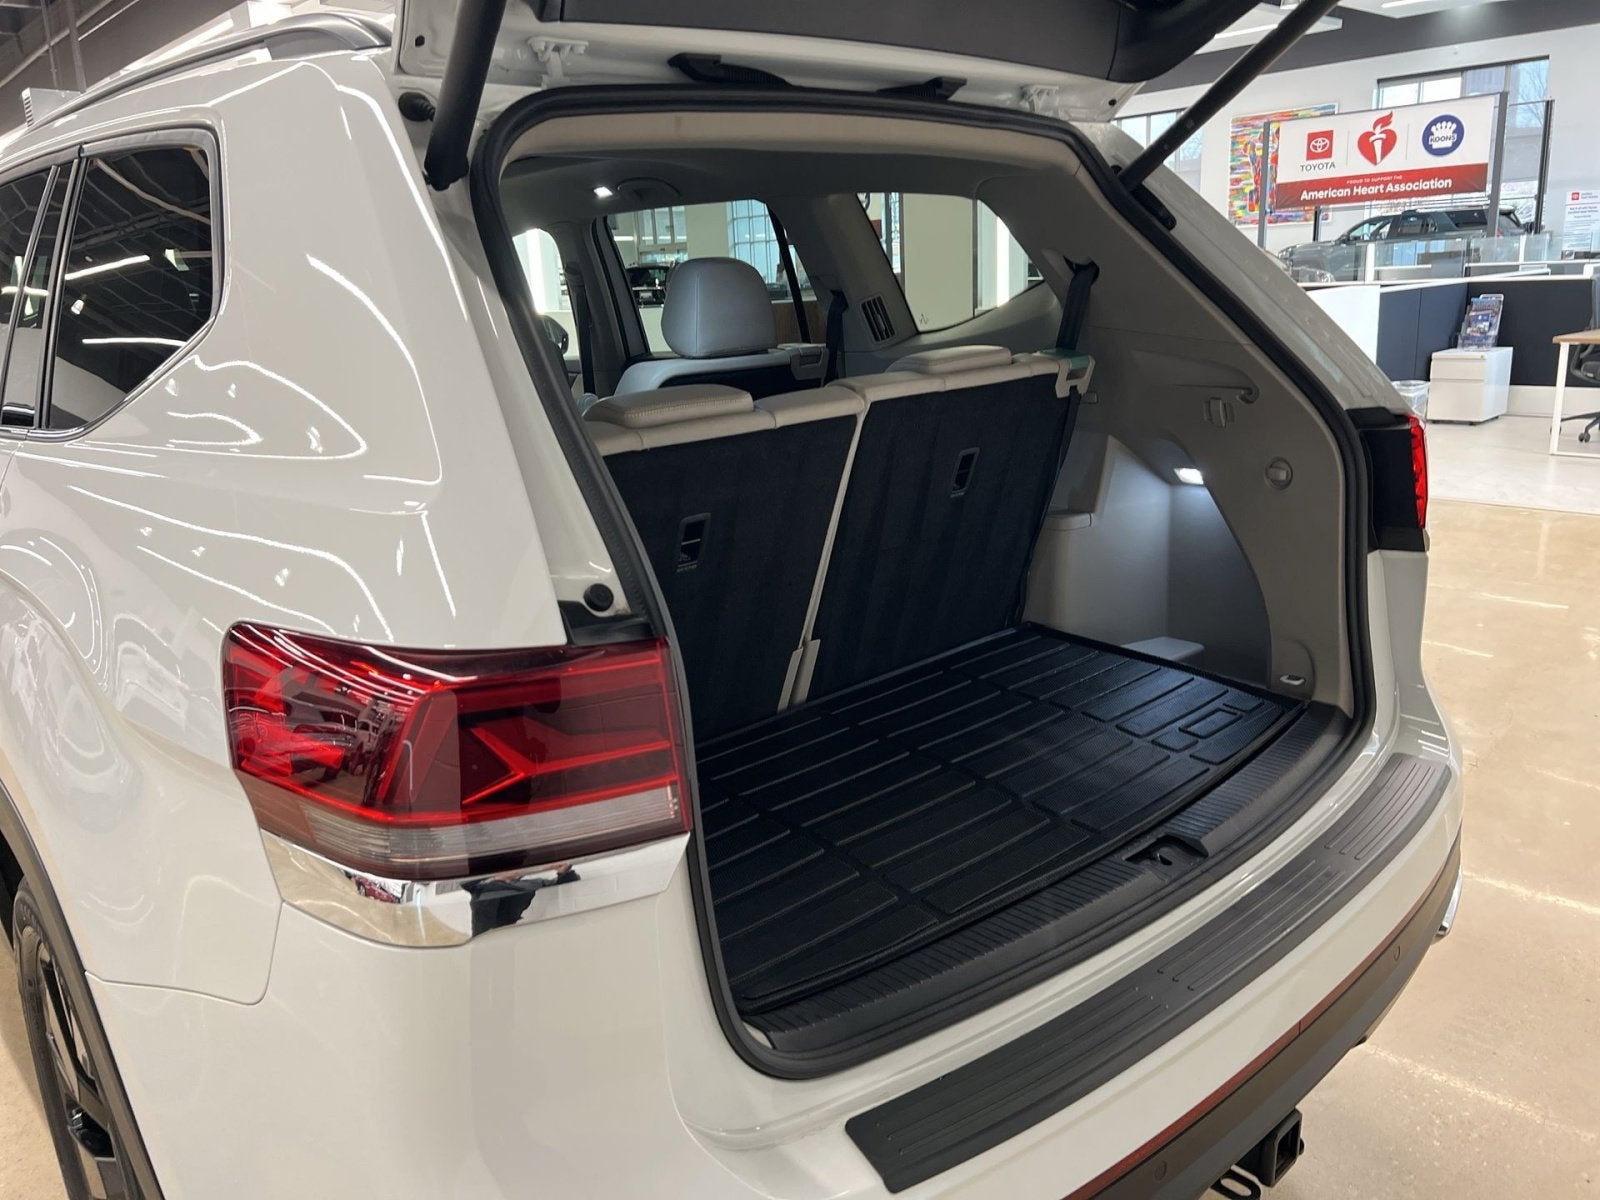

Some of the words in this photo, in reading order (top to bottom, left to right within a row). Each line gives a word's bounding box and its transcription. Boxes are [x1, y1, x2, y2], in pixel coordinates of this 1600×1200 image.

[1429, 134, 1456, 143] KOONS
[1300, 162, 1336, 172] TOYOTA
[1300, 187, 1350, 201] American
[1353, 183, 1384, 196] Heart
[1385, 178, 1452, 193] Association
